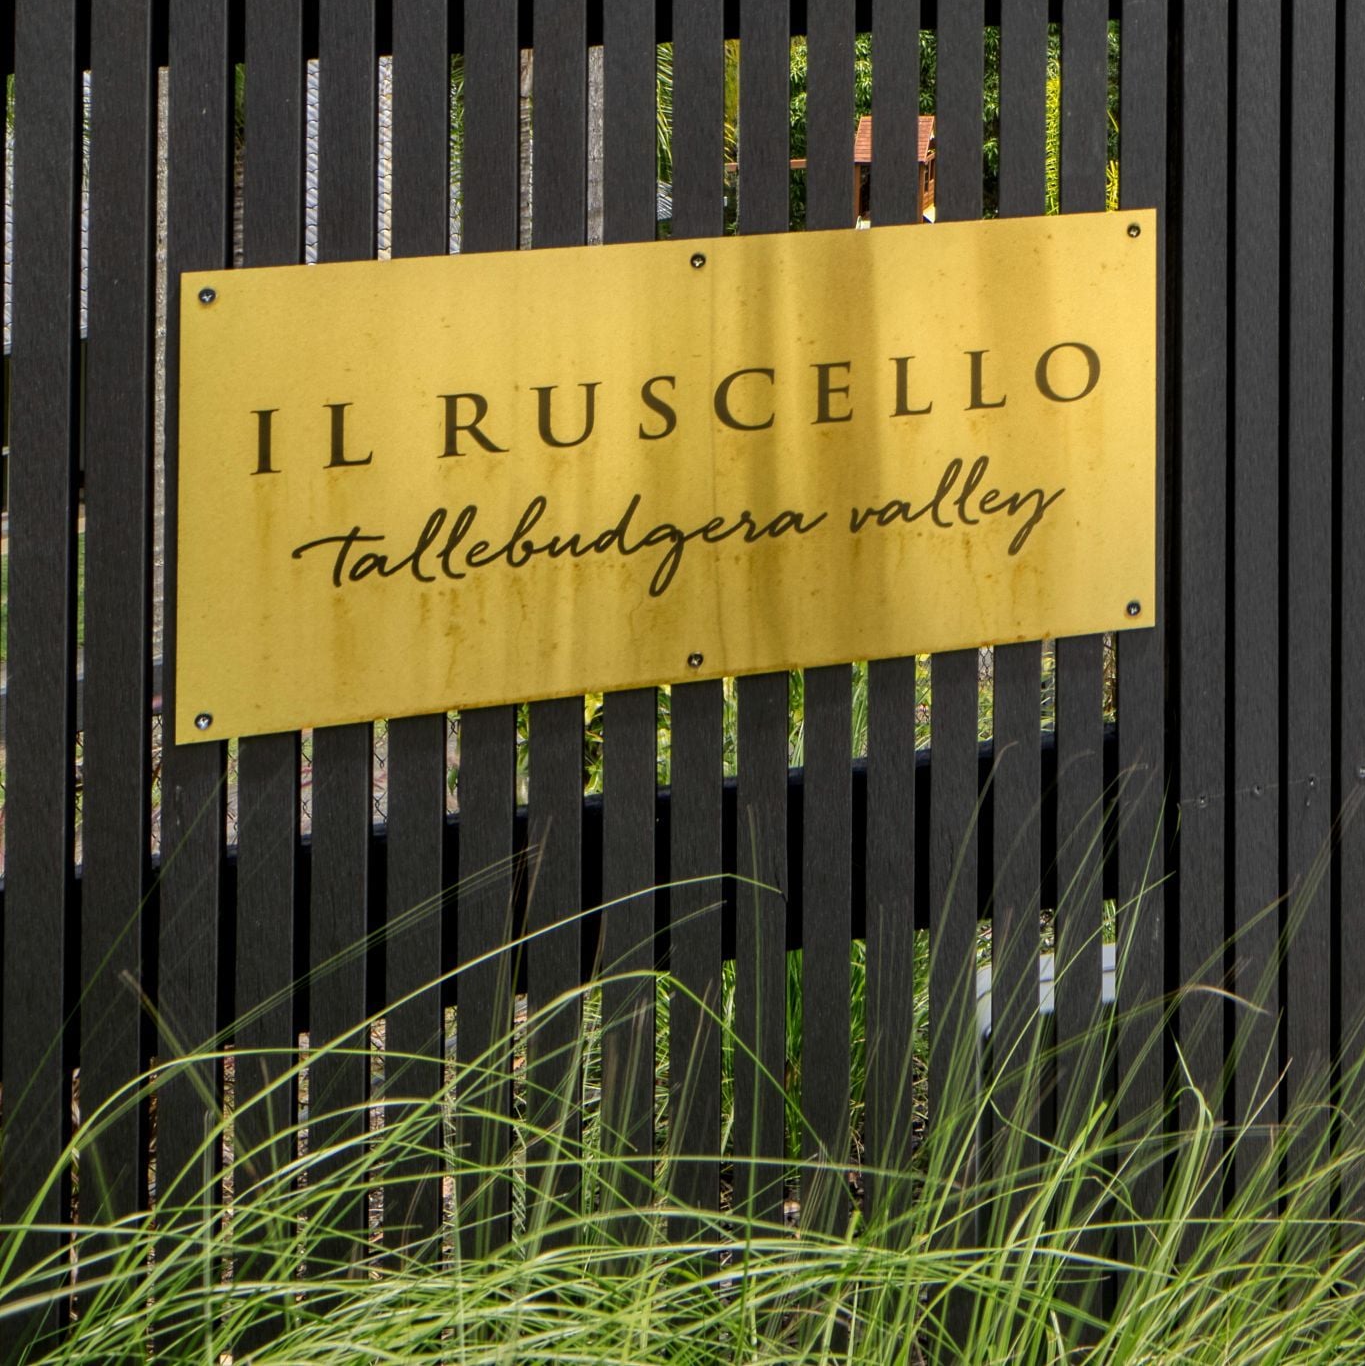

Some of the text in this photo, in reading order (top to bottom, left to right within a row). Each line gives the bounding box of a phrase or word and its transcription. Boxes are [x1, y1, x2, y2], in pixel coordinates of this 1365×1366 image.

[249, 341, 1101, 476] IL RUSCELLO
[290, 455, 1066, 598] tallebudgera valley
